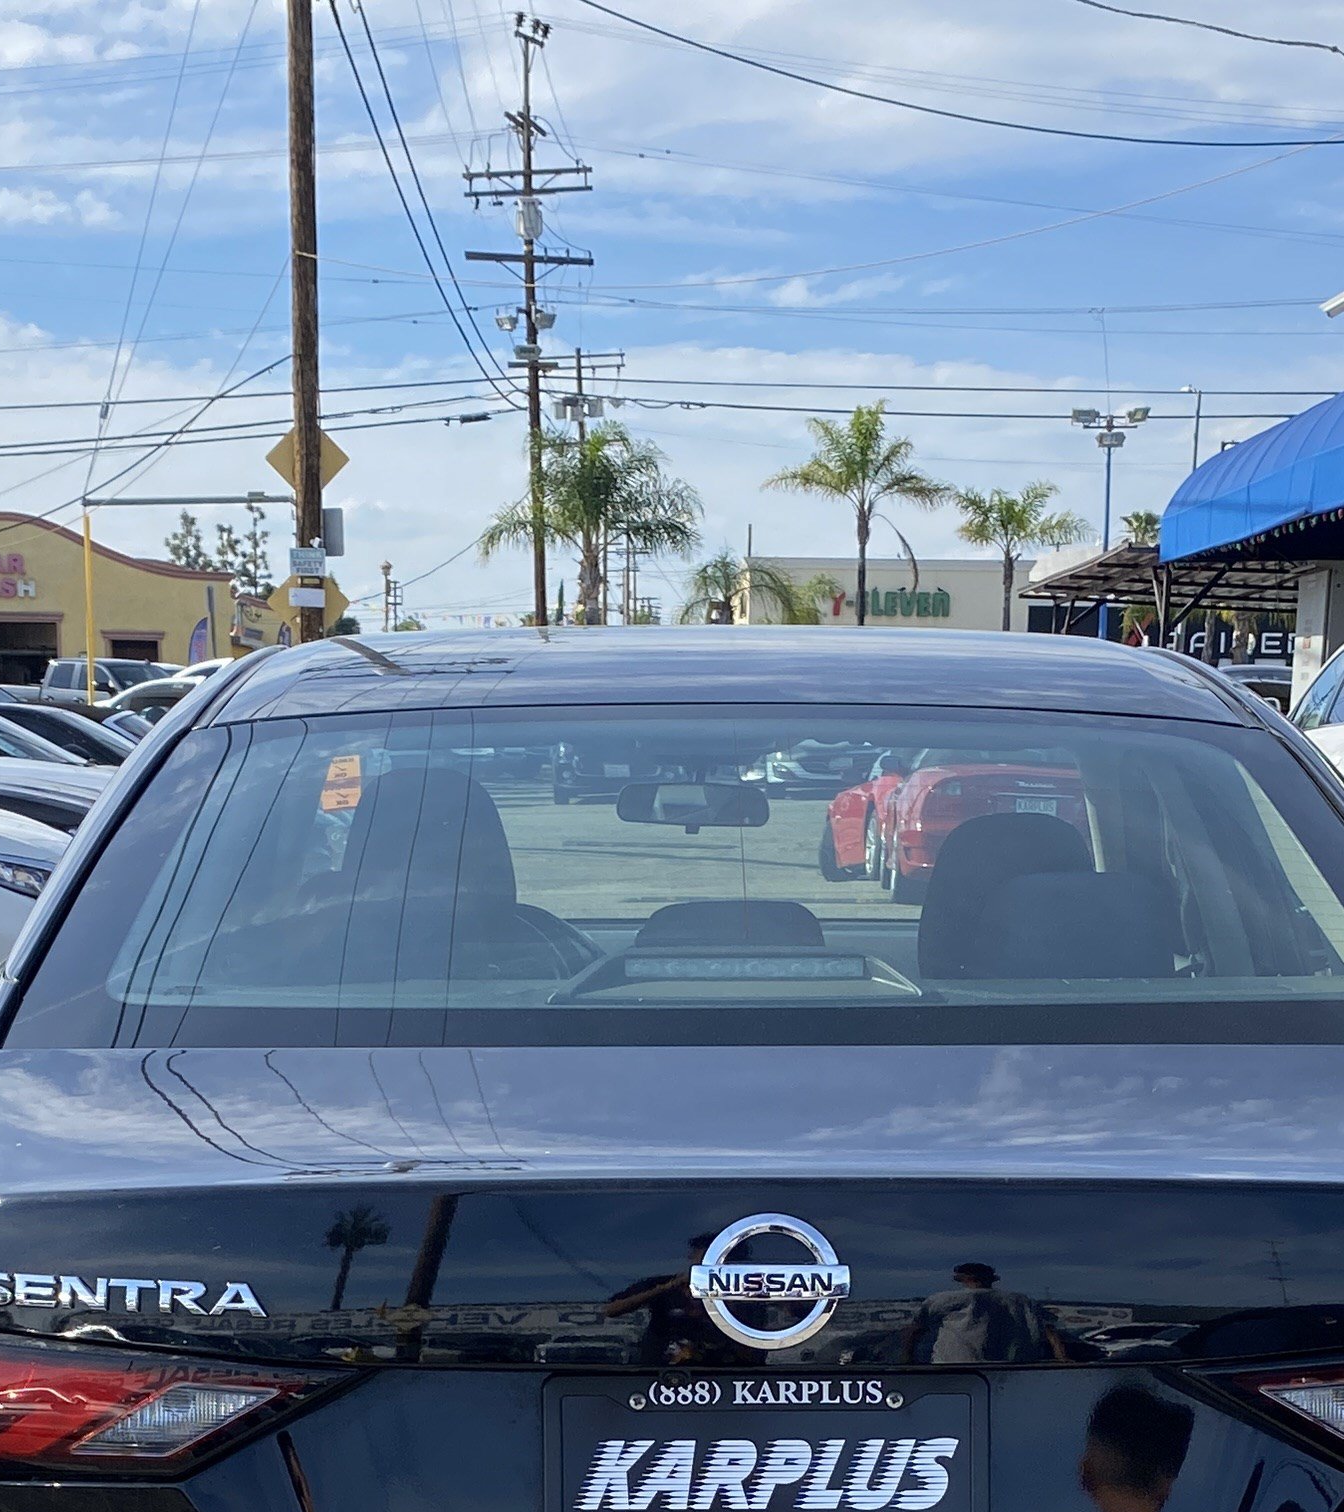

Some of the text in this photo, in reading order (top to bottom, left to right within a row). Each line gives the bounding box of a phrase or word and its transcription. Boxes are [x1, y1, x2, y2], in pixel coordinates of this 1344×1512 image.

[709, 1272, 833, 1292] NISSAN
[648, 1380, 884, 1406] (888) KARPLUS
[573, 1437, 960, 1511] KARPLUS
